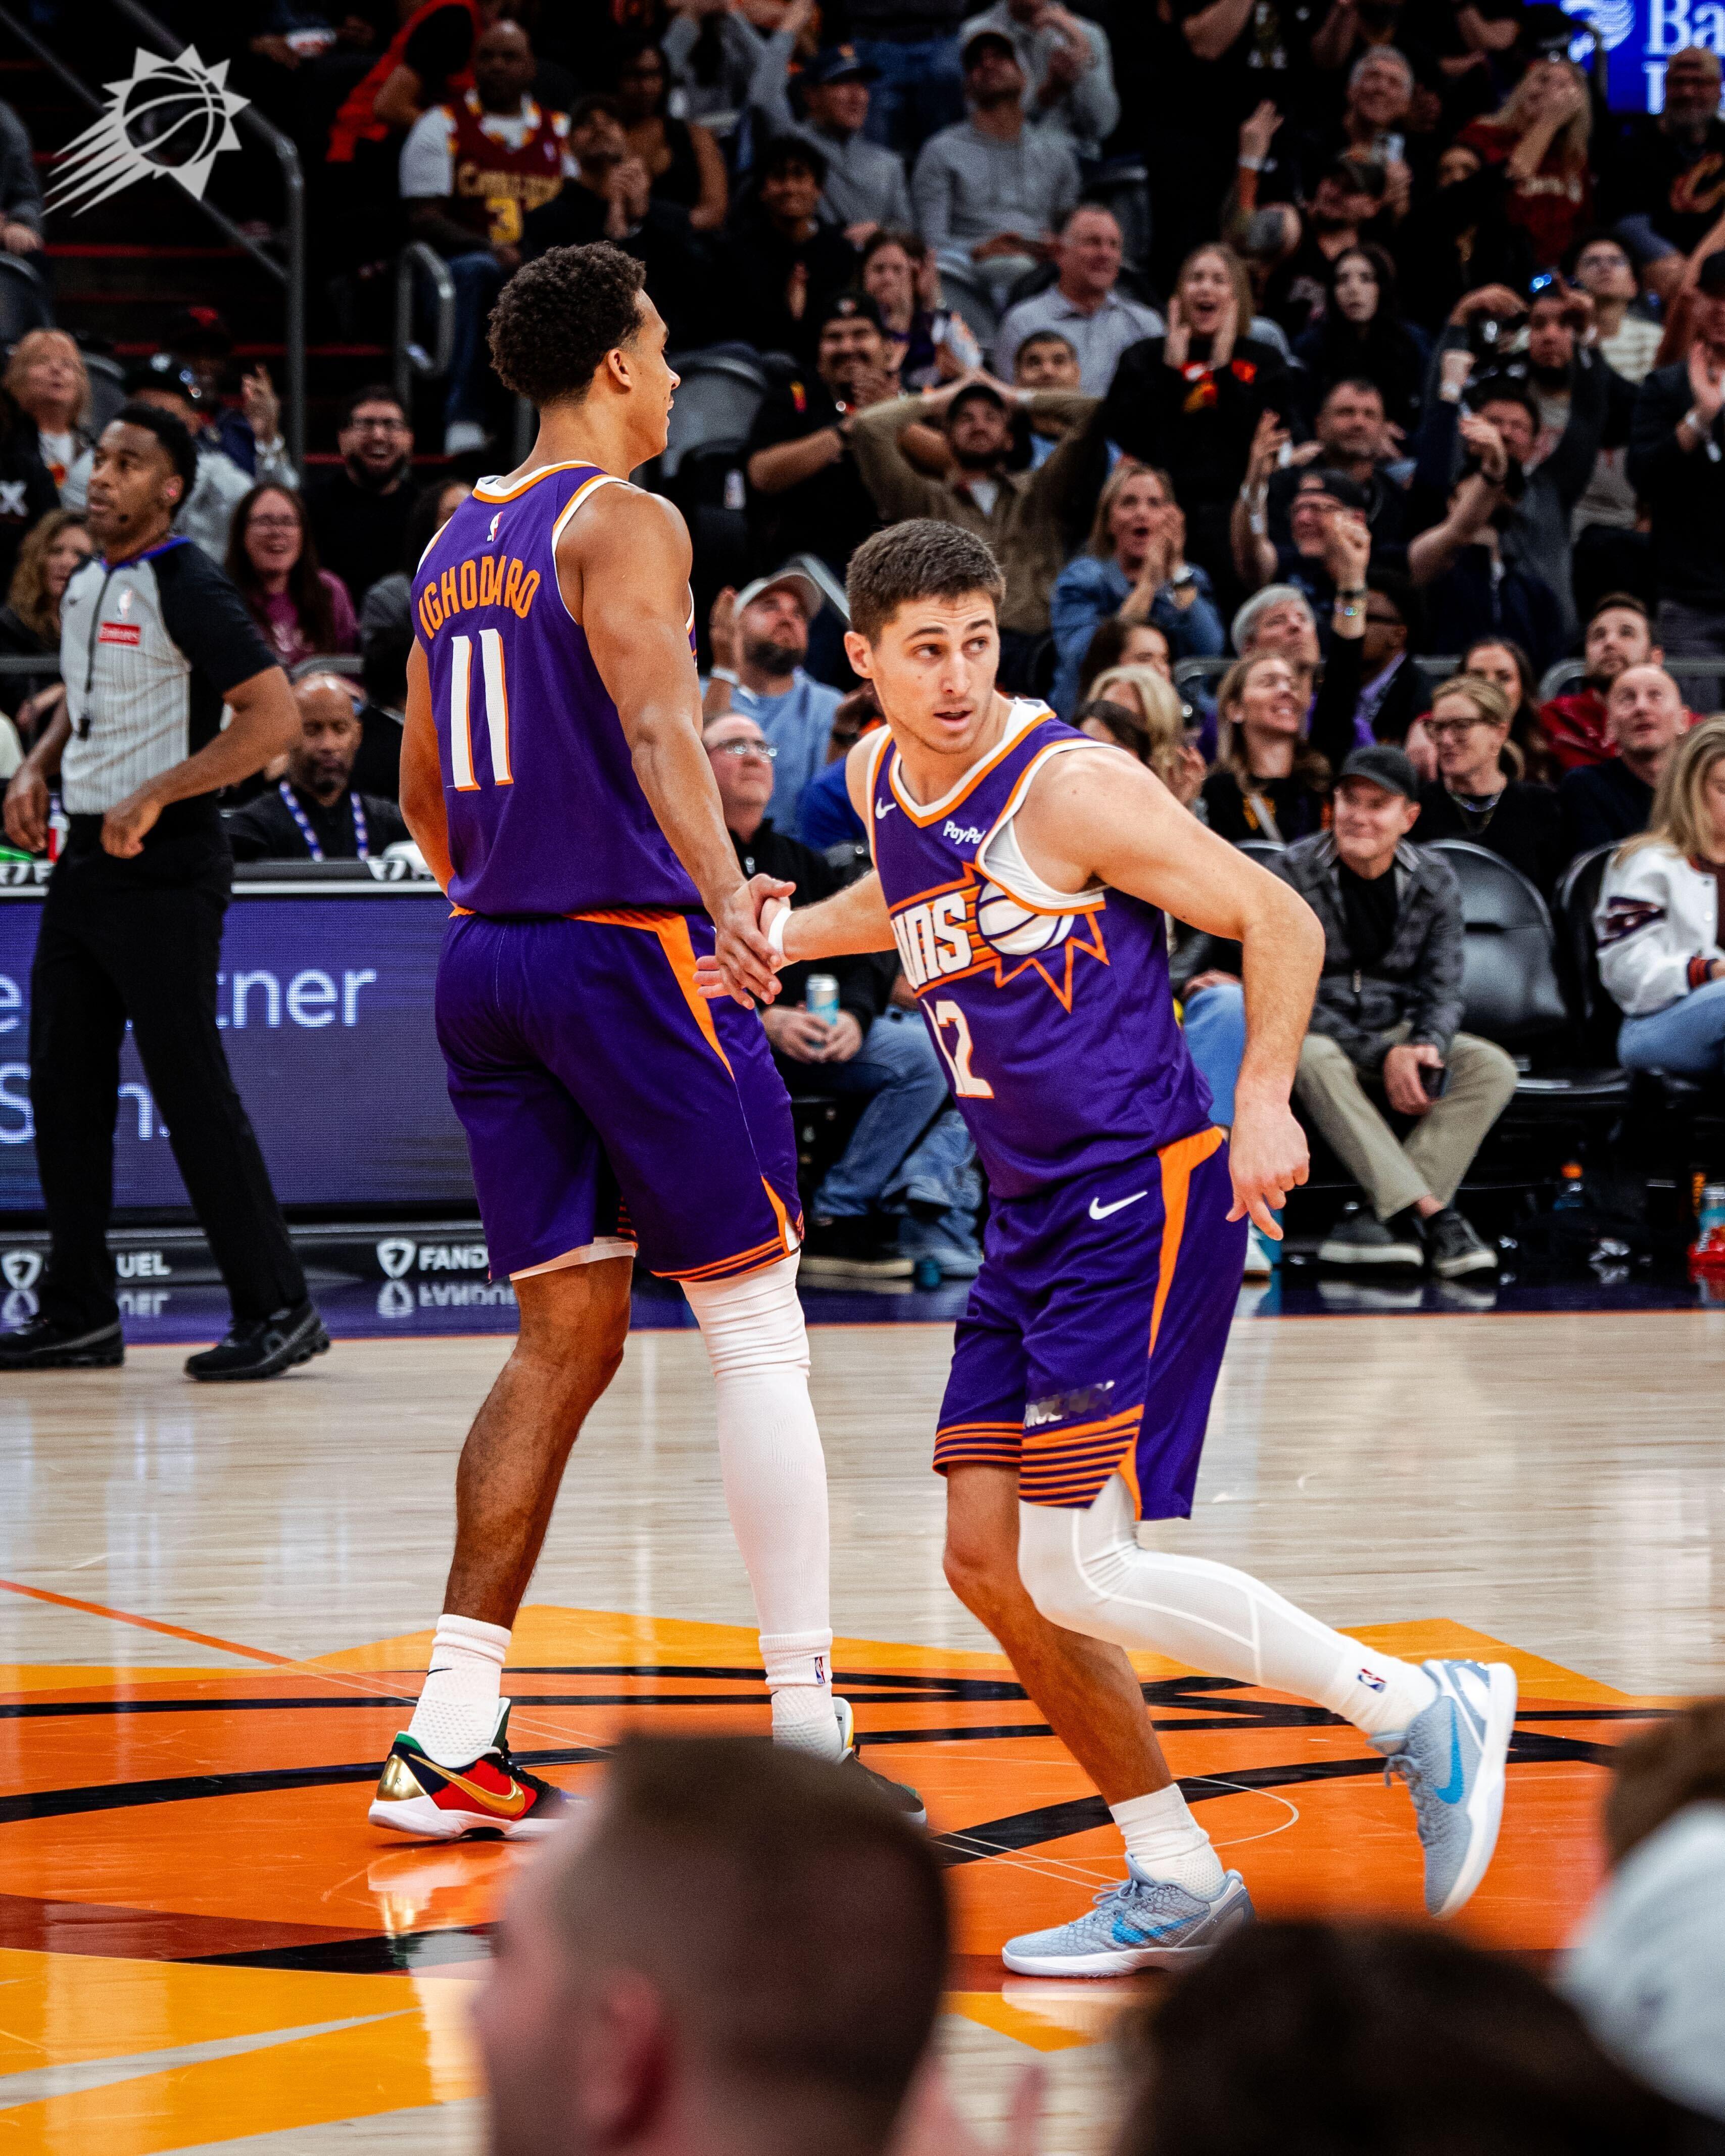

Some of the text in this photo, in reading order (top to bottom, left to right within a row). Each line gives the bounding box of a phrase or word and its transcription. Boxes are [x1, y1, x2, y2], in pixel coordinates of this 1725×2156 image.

[486, 197, 522, 243] 3
[419, 555, 540, 640] IGHODARO
[451, 629, 514, 792] 11
[890, 892, 972, 990] UNS
